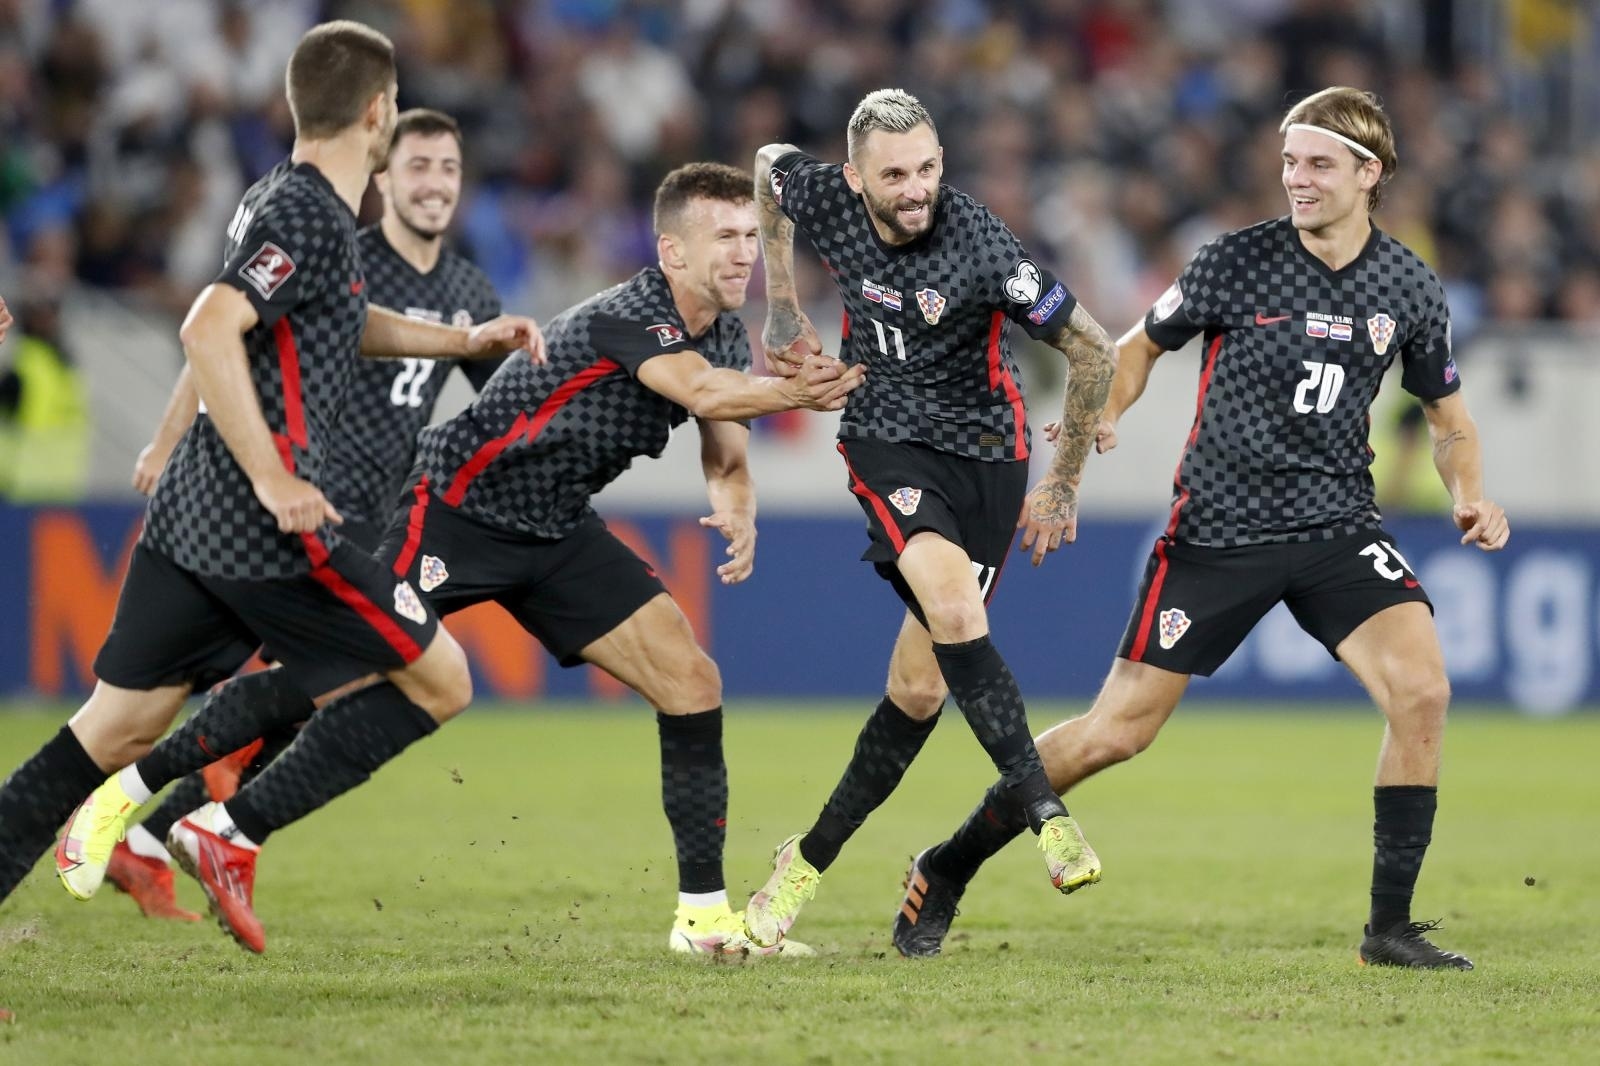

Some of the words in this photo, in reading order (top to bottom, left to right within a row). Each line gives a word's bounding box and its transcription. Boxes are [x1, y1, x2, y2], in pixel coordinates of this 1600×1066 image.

[1037, 285, 1066, 317] RESPECT
[870, 318, 907, 361] 11
[389, 357, 437, 407] 22
[1293, 360, 1346, 414] 20
